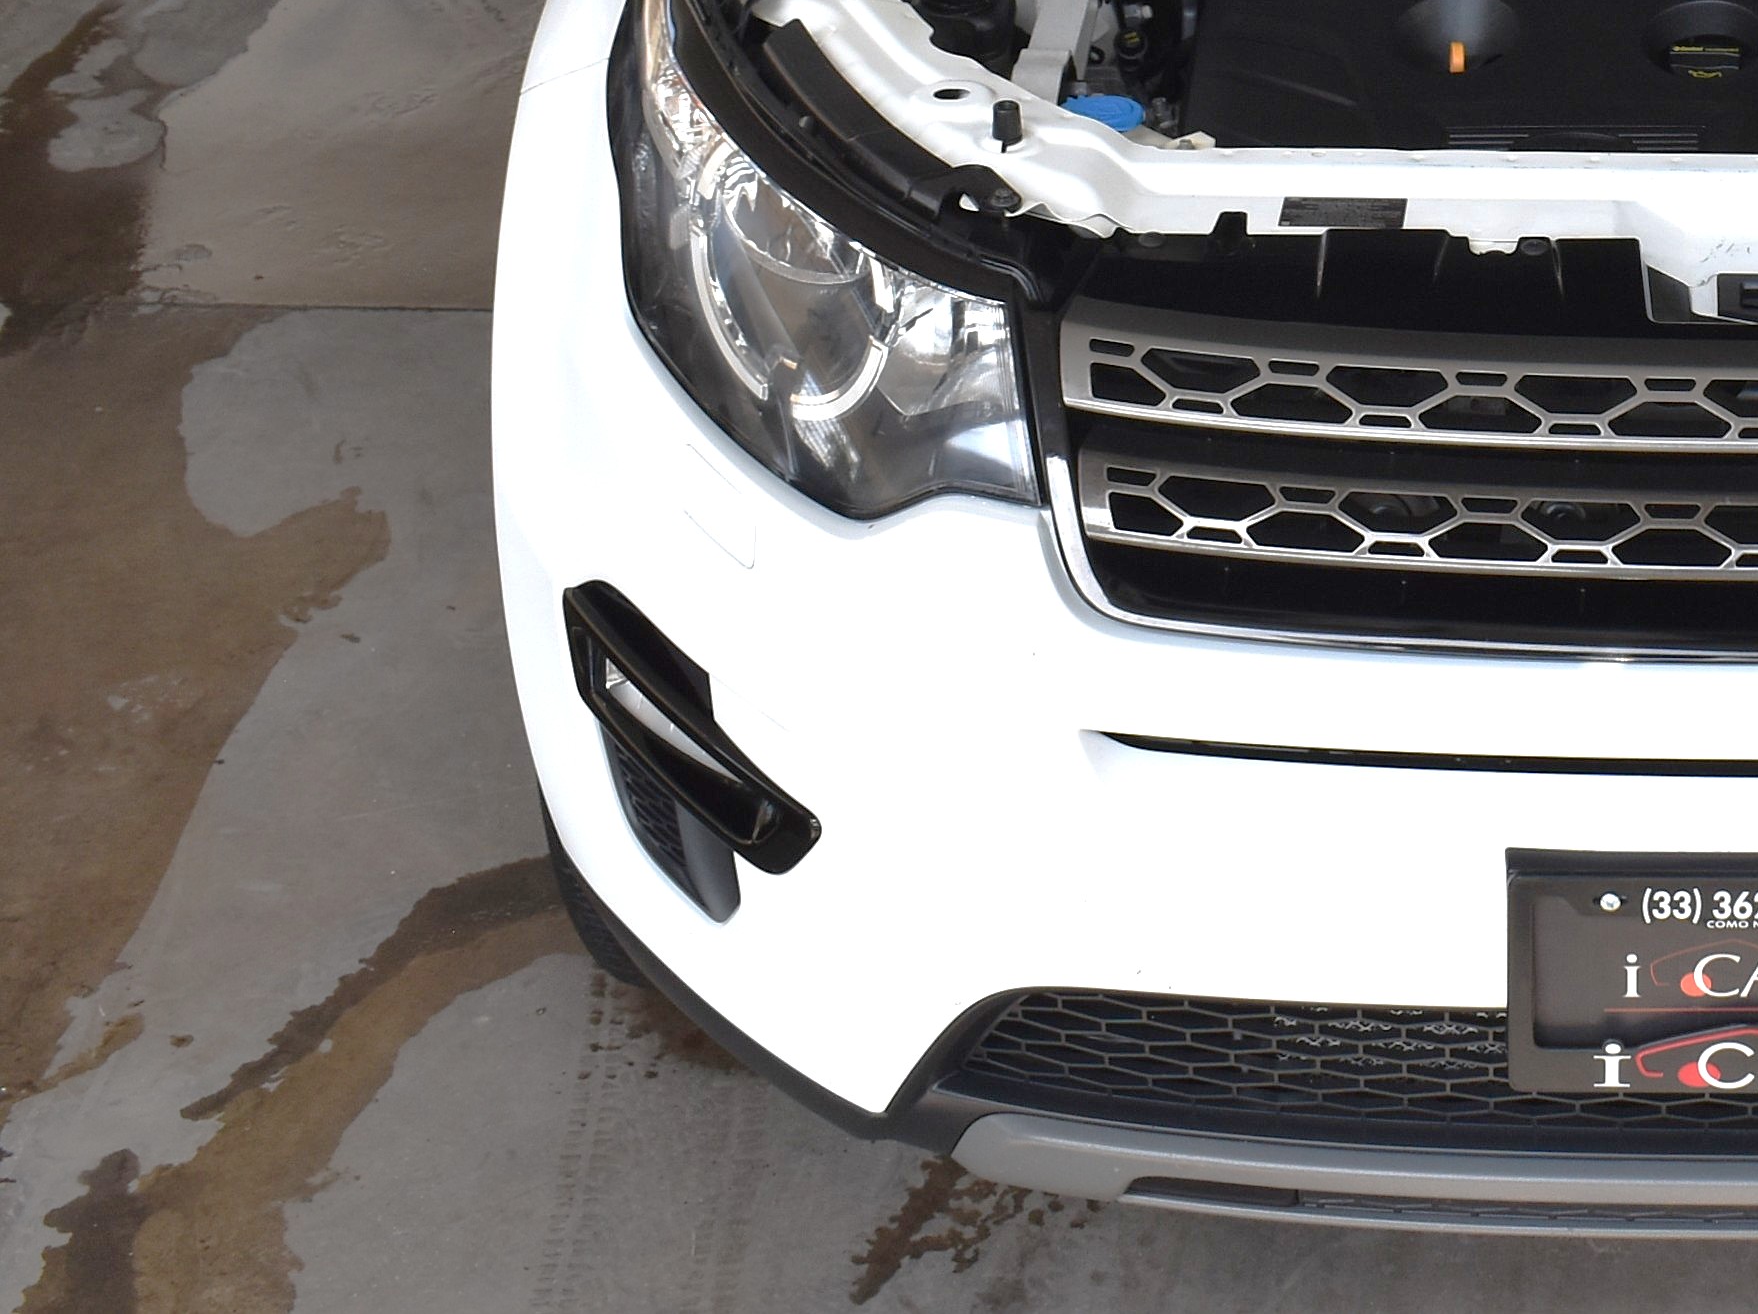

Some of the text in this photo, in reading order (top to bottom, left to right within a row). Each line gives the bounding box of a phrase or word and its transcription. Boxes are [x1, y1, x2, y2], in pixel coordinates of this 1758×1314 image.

[1641, 887, 1702, 924] (33)
[1706, 920, 1750, 929] COMO
[1623, 953, 1642, 998] i
[1593, 1042, 1631, 1088] i
